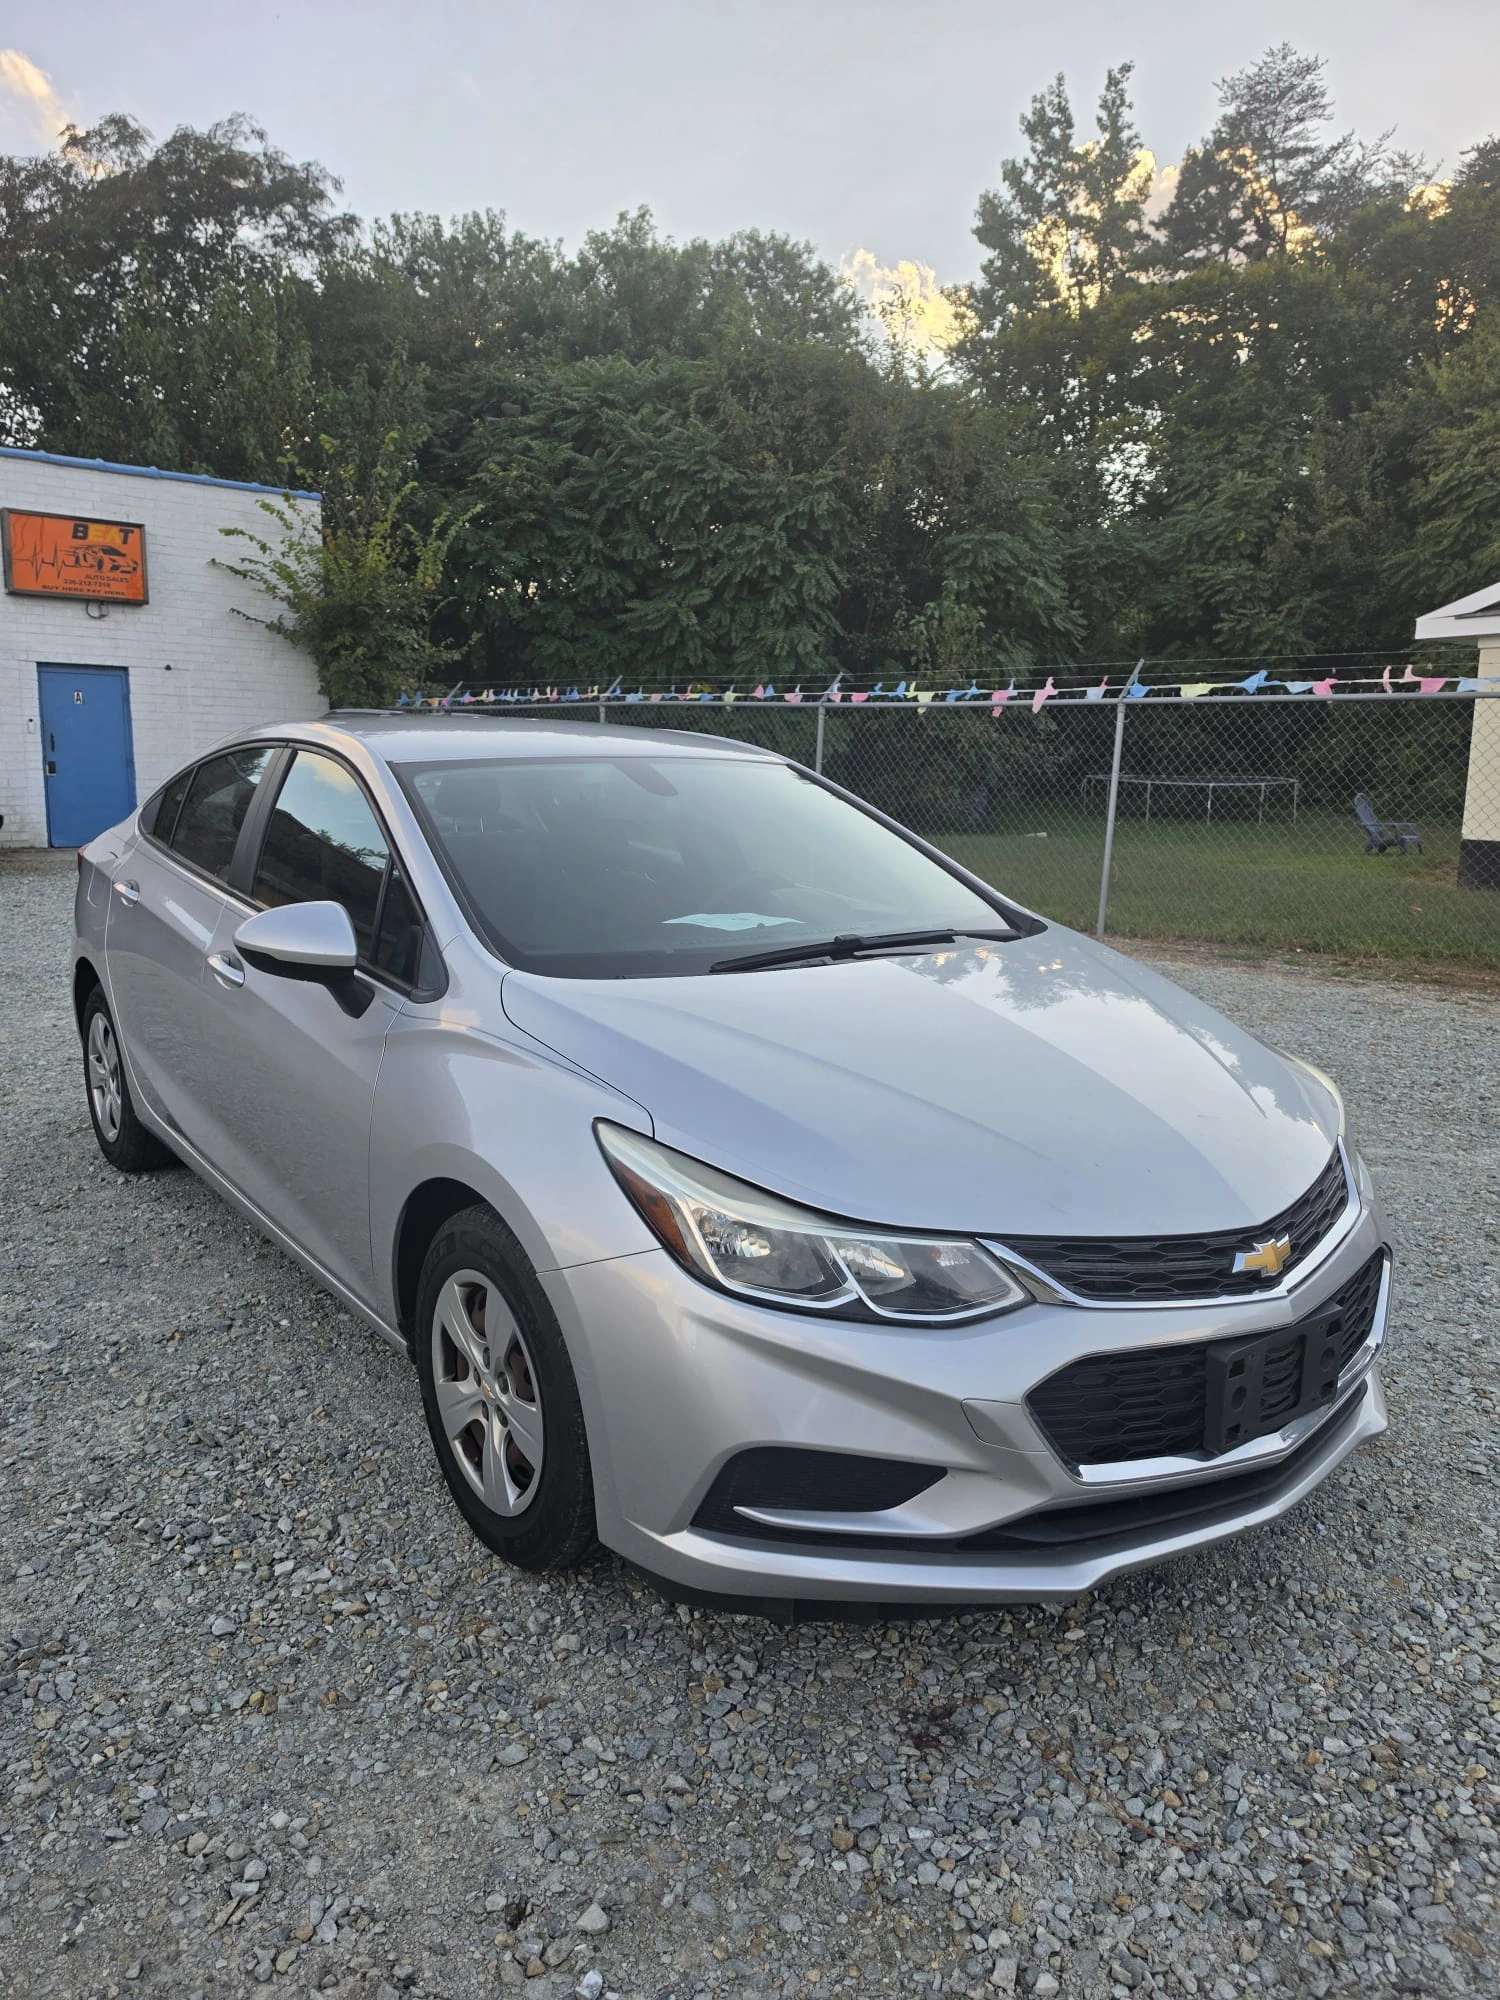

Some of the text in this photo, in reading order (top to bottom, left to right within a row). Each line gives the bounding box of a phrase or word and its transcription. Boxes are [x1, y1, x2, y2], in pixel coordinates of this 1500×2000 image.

[72, 523, 135, 545] BEAT
[106, 575, 129, 583] SALES
[75, 691, 82, 704] A
